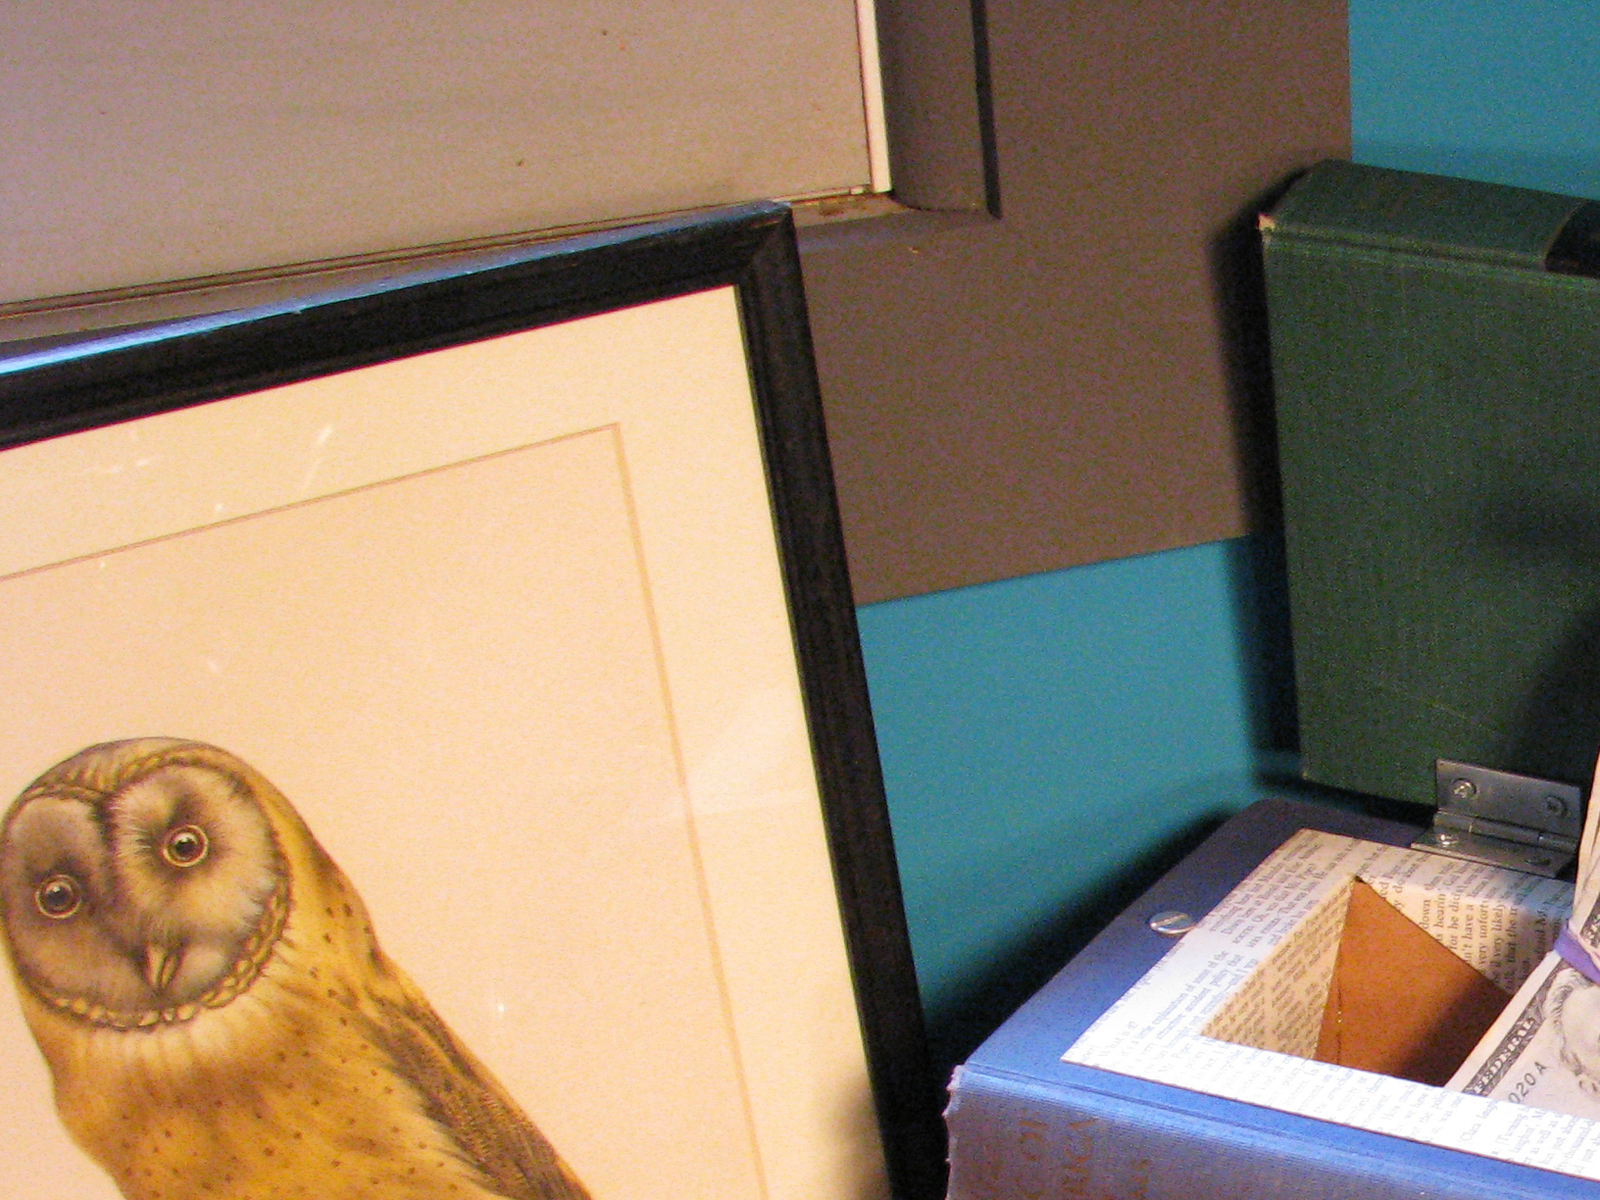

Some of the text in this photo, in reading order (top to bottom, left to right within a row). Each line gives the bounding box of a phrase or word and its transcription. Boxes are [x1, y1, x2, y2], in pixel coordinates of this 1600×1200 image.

[1419, 899, 1431, 928] down
[1448, 916, 1459, 929] he
[1490, 902, 1507, 931] likely
[1462, 914, 1474, 939] have
[1506, 919, 1517, 937] the
